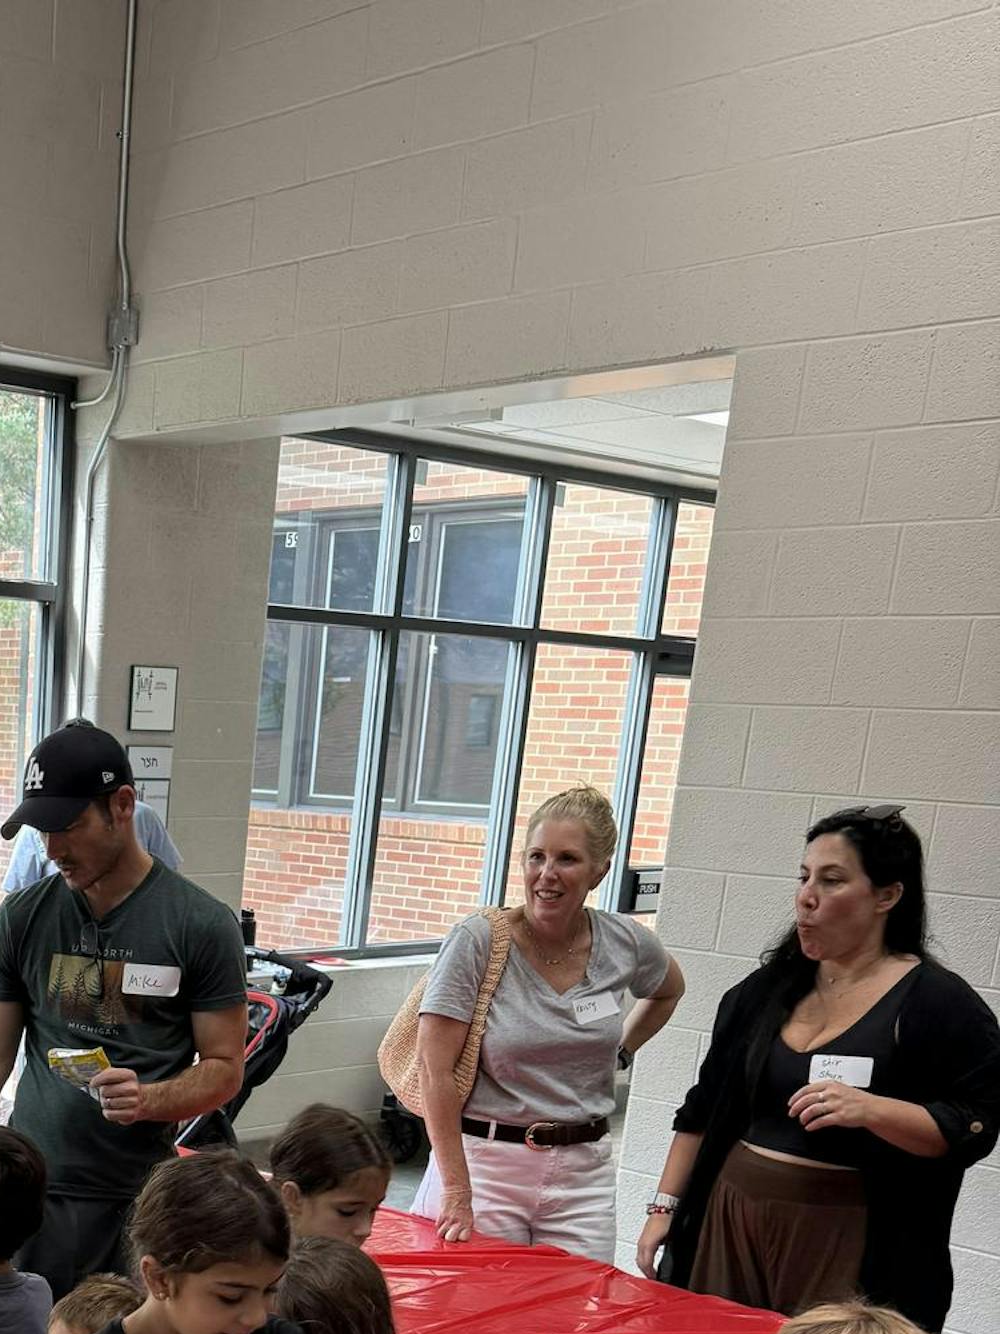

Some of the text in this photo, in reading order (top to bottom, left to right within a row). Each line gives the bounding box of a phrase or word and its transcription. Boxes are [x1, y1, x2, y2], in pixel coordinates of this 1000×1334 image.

[25, 756, 44, 790] LA
[640, 884, 657, 893] PUSH
[68, 1022, 119, 1036] MICHIGAN
